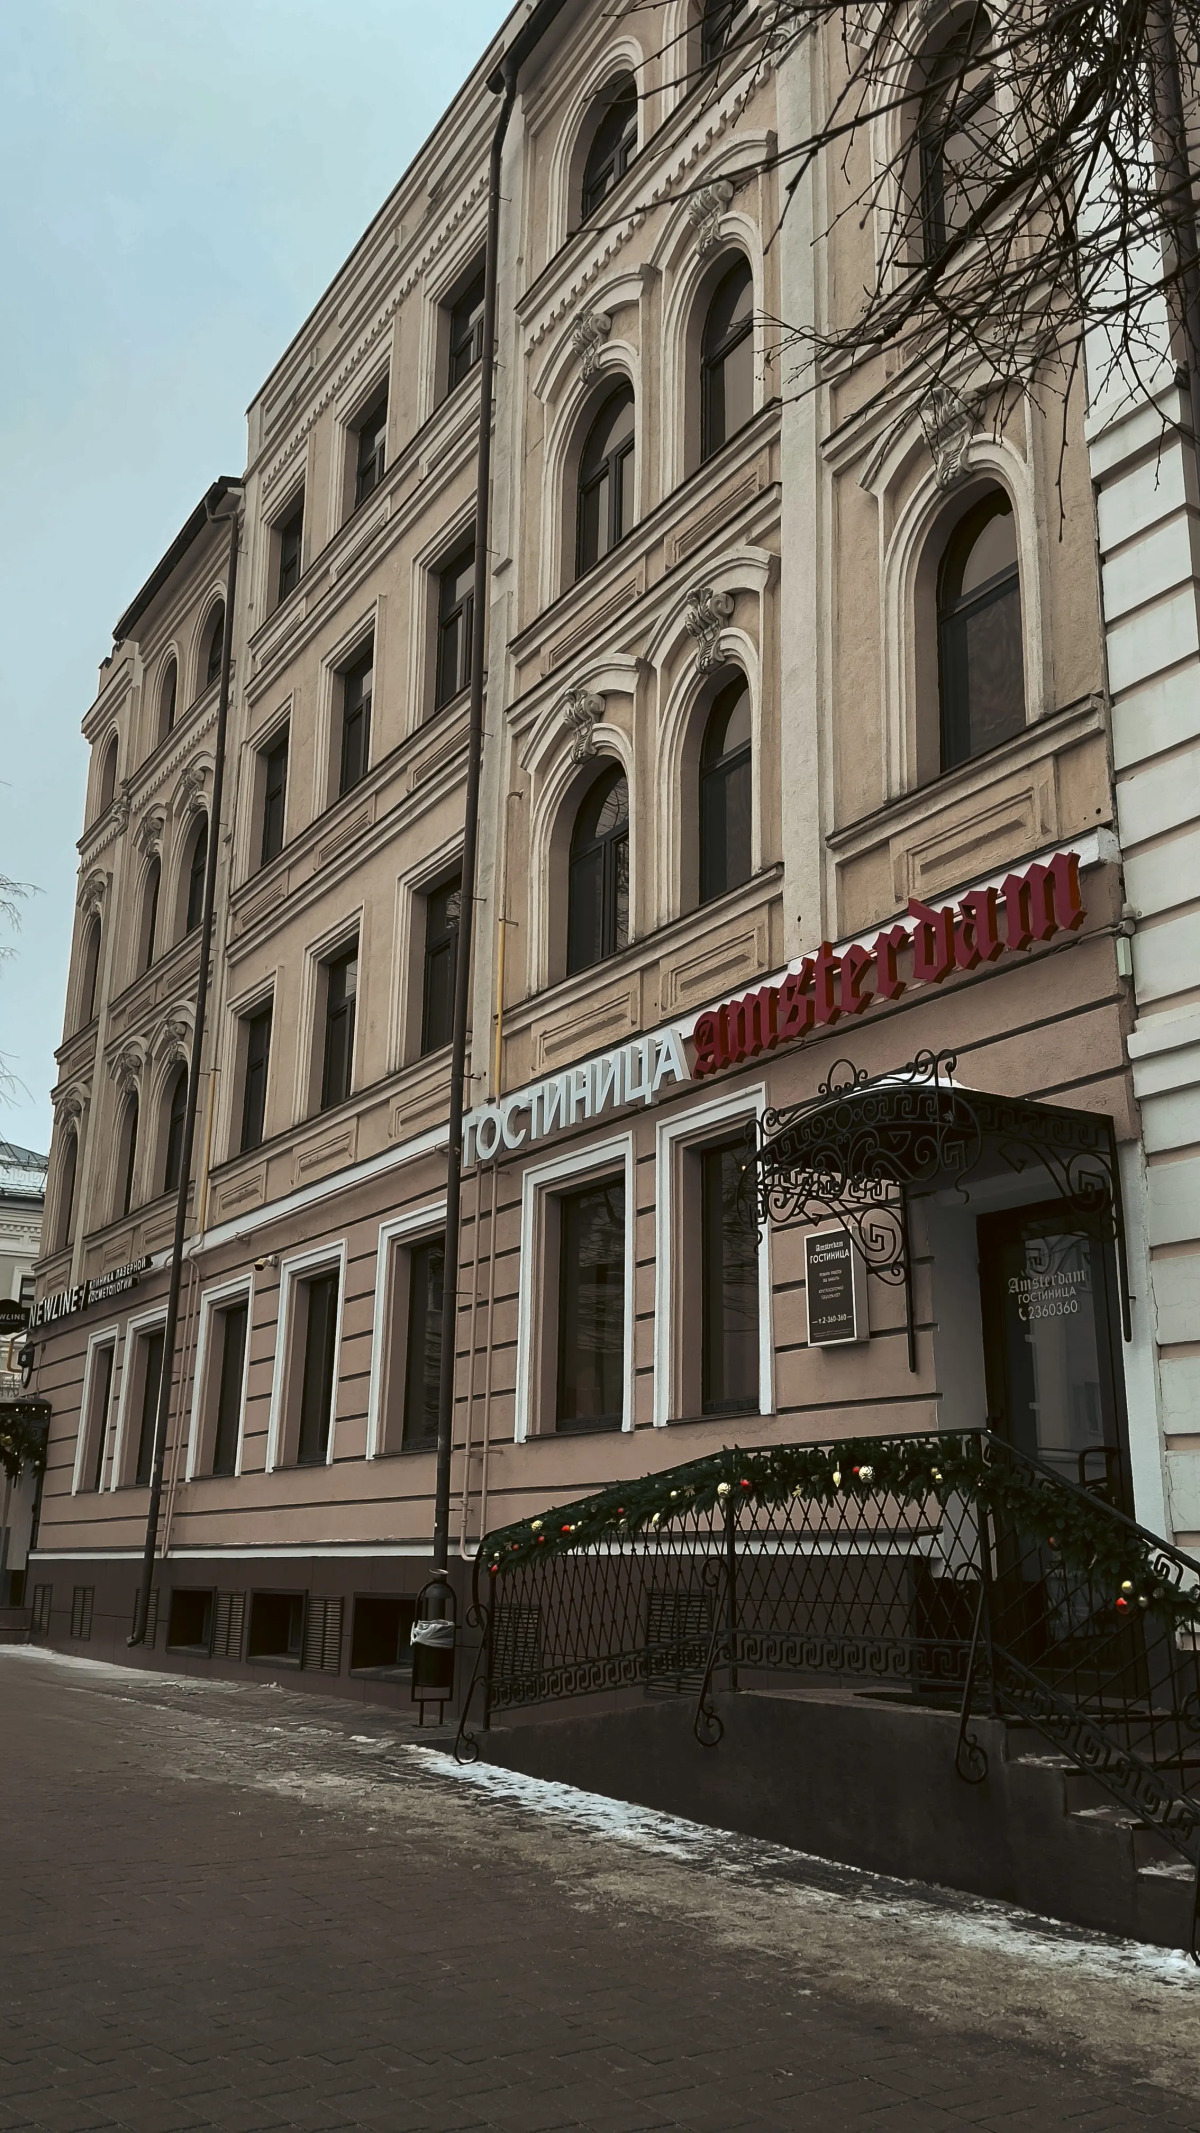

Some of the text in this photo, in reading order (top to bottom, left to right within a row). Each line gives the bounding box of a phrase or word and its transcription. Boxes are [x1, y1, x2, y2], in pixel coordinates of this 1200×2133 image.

[462, 851, 1089, 1169] ГОСТИНИЦА Amsterdam
[809, 1248, 850, 1264] ГОСТИНИЦА
[89, 1272, 114, 1290] КЛИНИКА
[1007, 1269, 1086, 1294] Amsterdam
[1018, 1286, 1077, 1304] ГОСТИНИЦА
[28, 1286, 79, 1329] NEWLINE
[1028, 1299, 1078, 1320] 2360360
